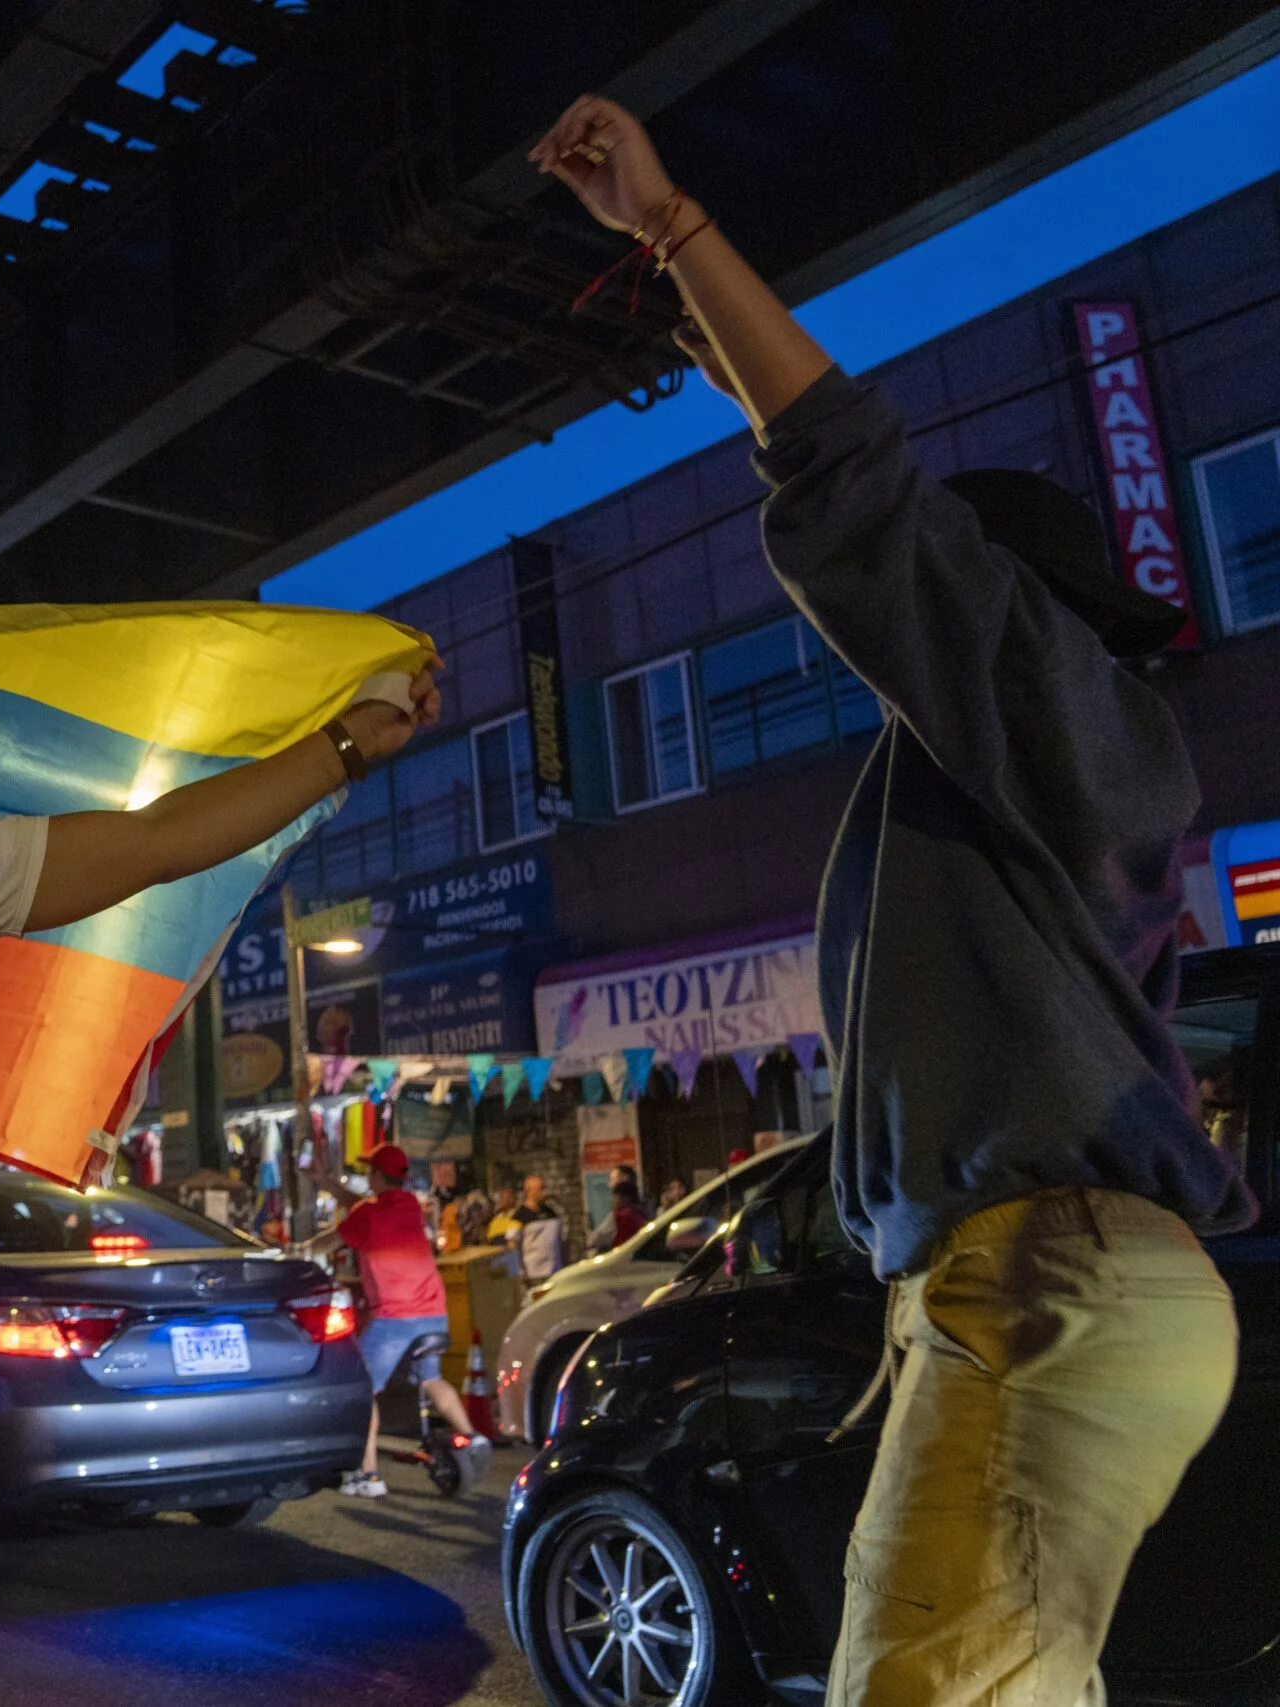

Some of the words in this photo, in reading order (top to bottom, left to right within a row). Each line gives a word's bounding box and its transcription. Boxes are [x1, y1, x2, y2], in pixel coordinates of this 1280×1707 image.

[1085, 310, 1184, 607] PHARMAC
[406, 883, 440, 916] 718
[444, 858, 537, 905] 565-5010
[644, 1010, 741, 1056] NAILS
